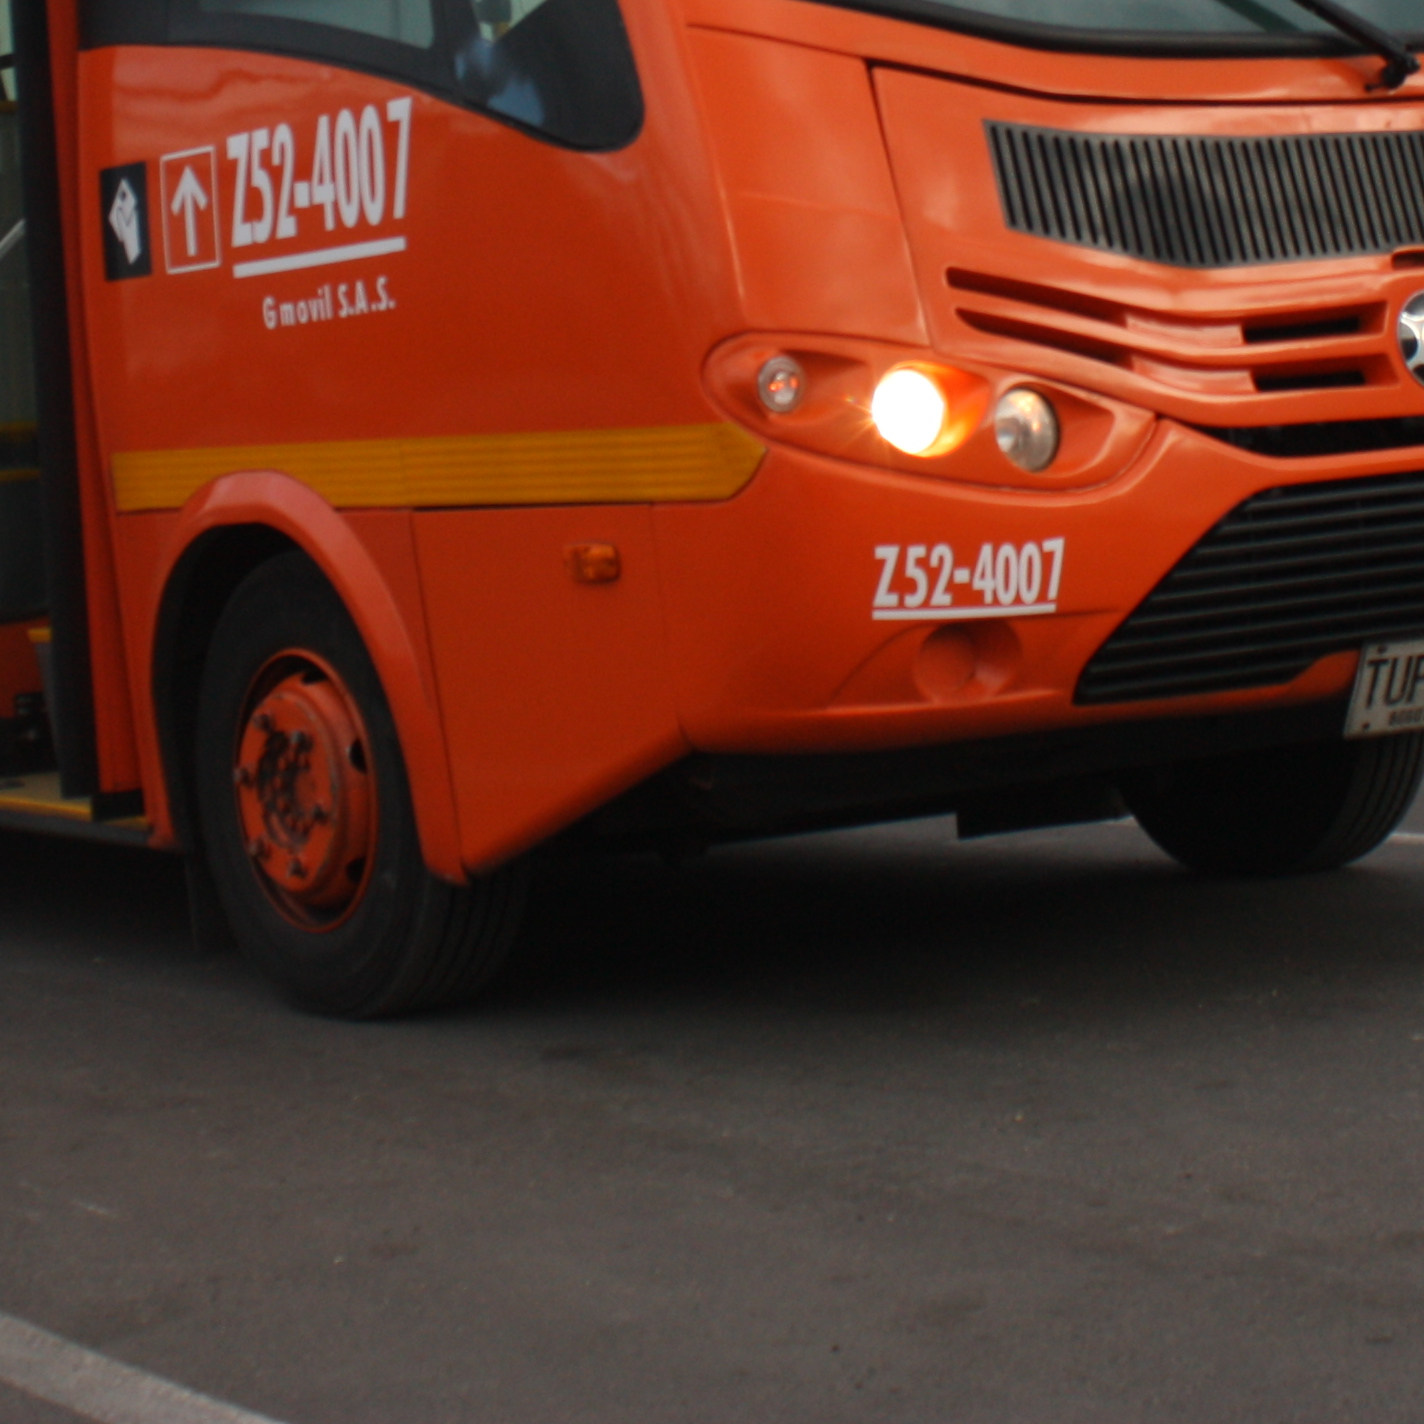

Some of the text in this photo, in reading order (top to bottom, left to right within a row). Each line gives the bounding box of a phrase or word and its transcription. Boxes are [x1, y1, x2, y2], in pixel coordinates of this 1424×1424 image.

[226, 95, 413, 247] Z52-4007
[337, 276, 396, 318] S.A.S.
[872, 537, 1066, 608] Z52-4007
